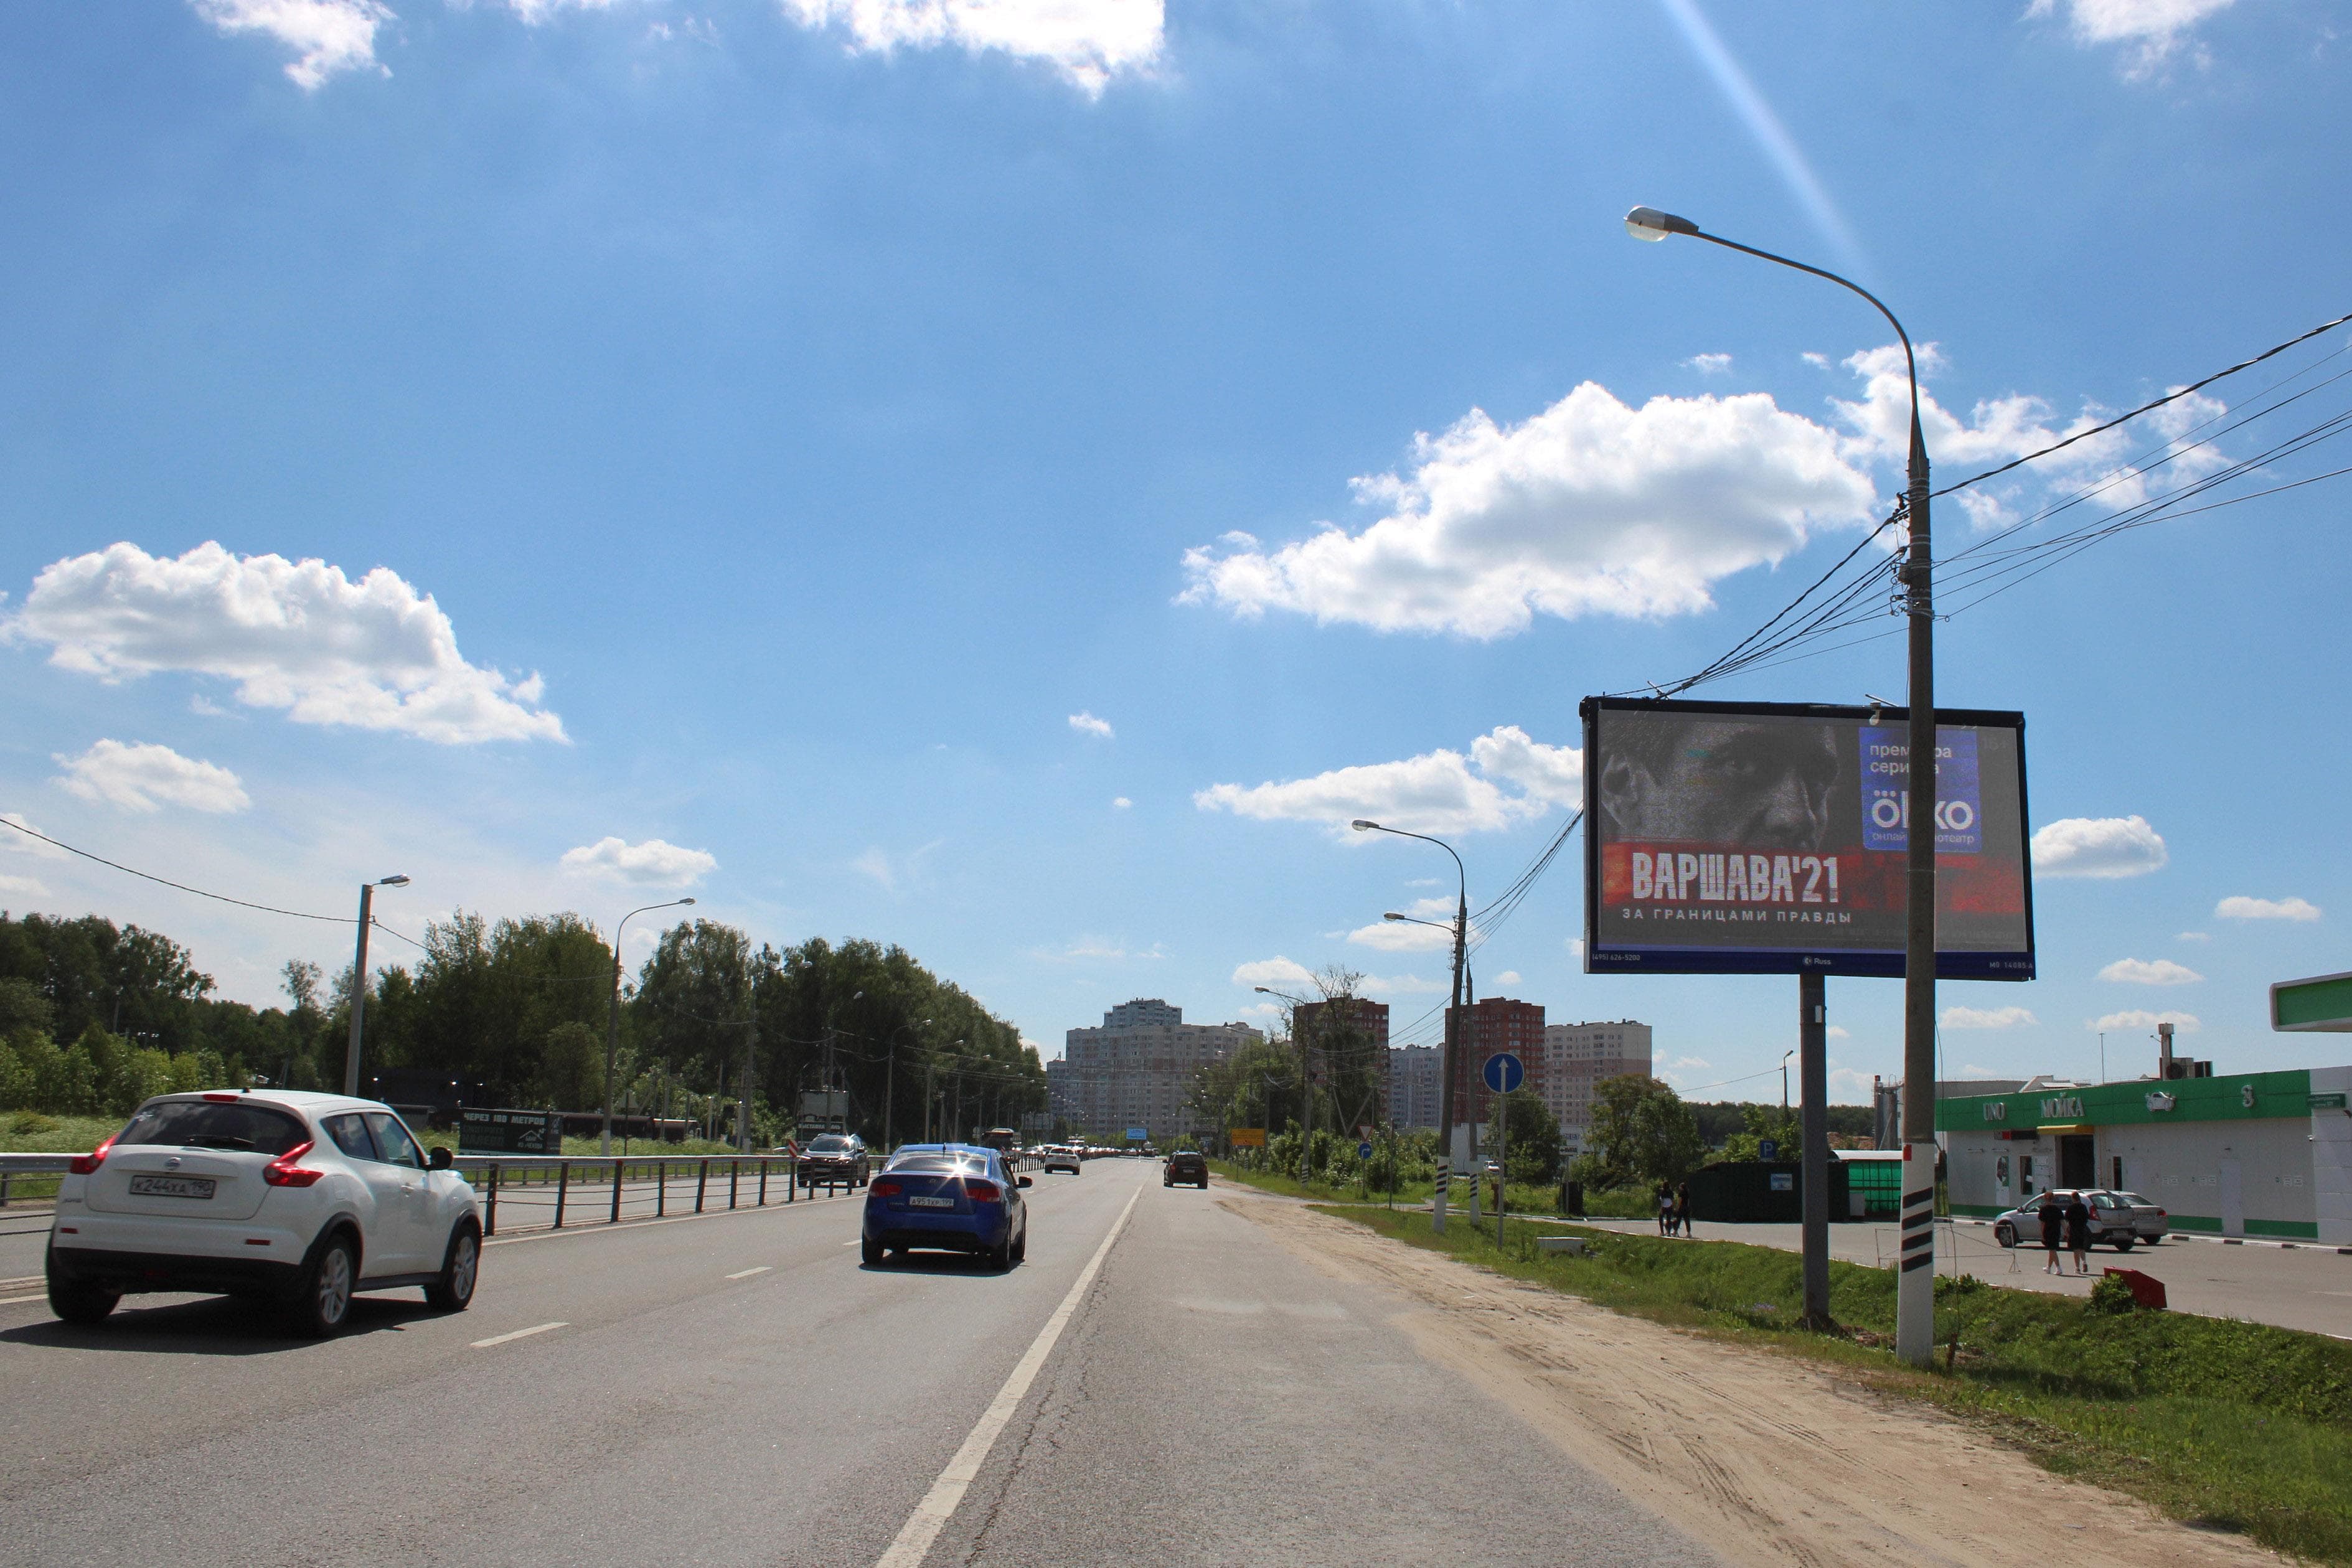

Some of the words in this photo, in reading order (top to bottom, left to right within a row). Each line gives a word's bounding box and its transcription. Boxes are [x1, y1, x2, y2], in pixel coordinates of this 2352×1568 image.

[1870, 744, 1953, 758] премра
[1872, 832, 1908, 841] онлай
[1934, 835, 1975, 845] отеатр
[1632, 852, 1839, 903] ВАРШАВА'21
[1622, 908, 1644, 919] ЗА
[1653, 908, 1767, 923] ГРАНИЦАМИ
[1776, 911, 1852, 925] ПРАВДЫ
[1982, 1102, 2006, 1121] UNO
[2040, 1092, 2086, 1119] МОЙКА
[463, 1112, 490, 1122] ЧЕРЕЗ
[493, 1114, 507, 1123] 100
[510, 1115, 546, 1125] МЕТРОВ
[1764, 1143, 1773, 1157] P
